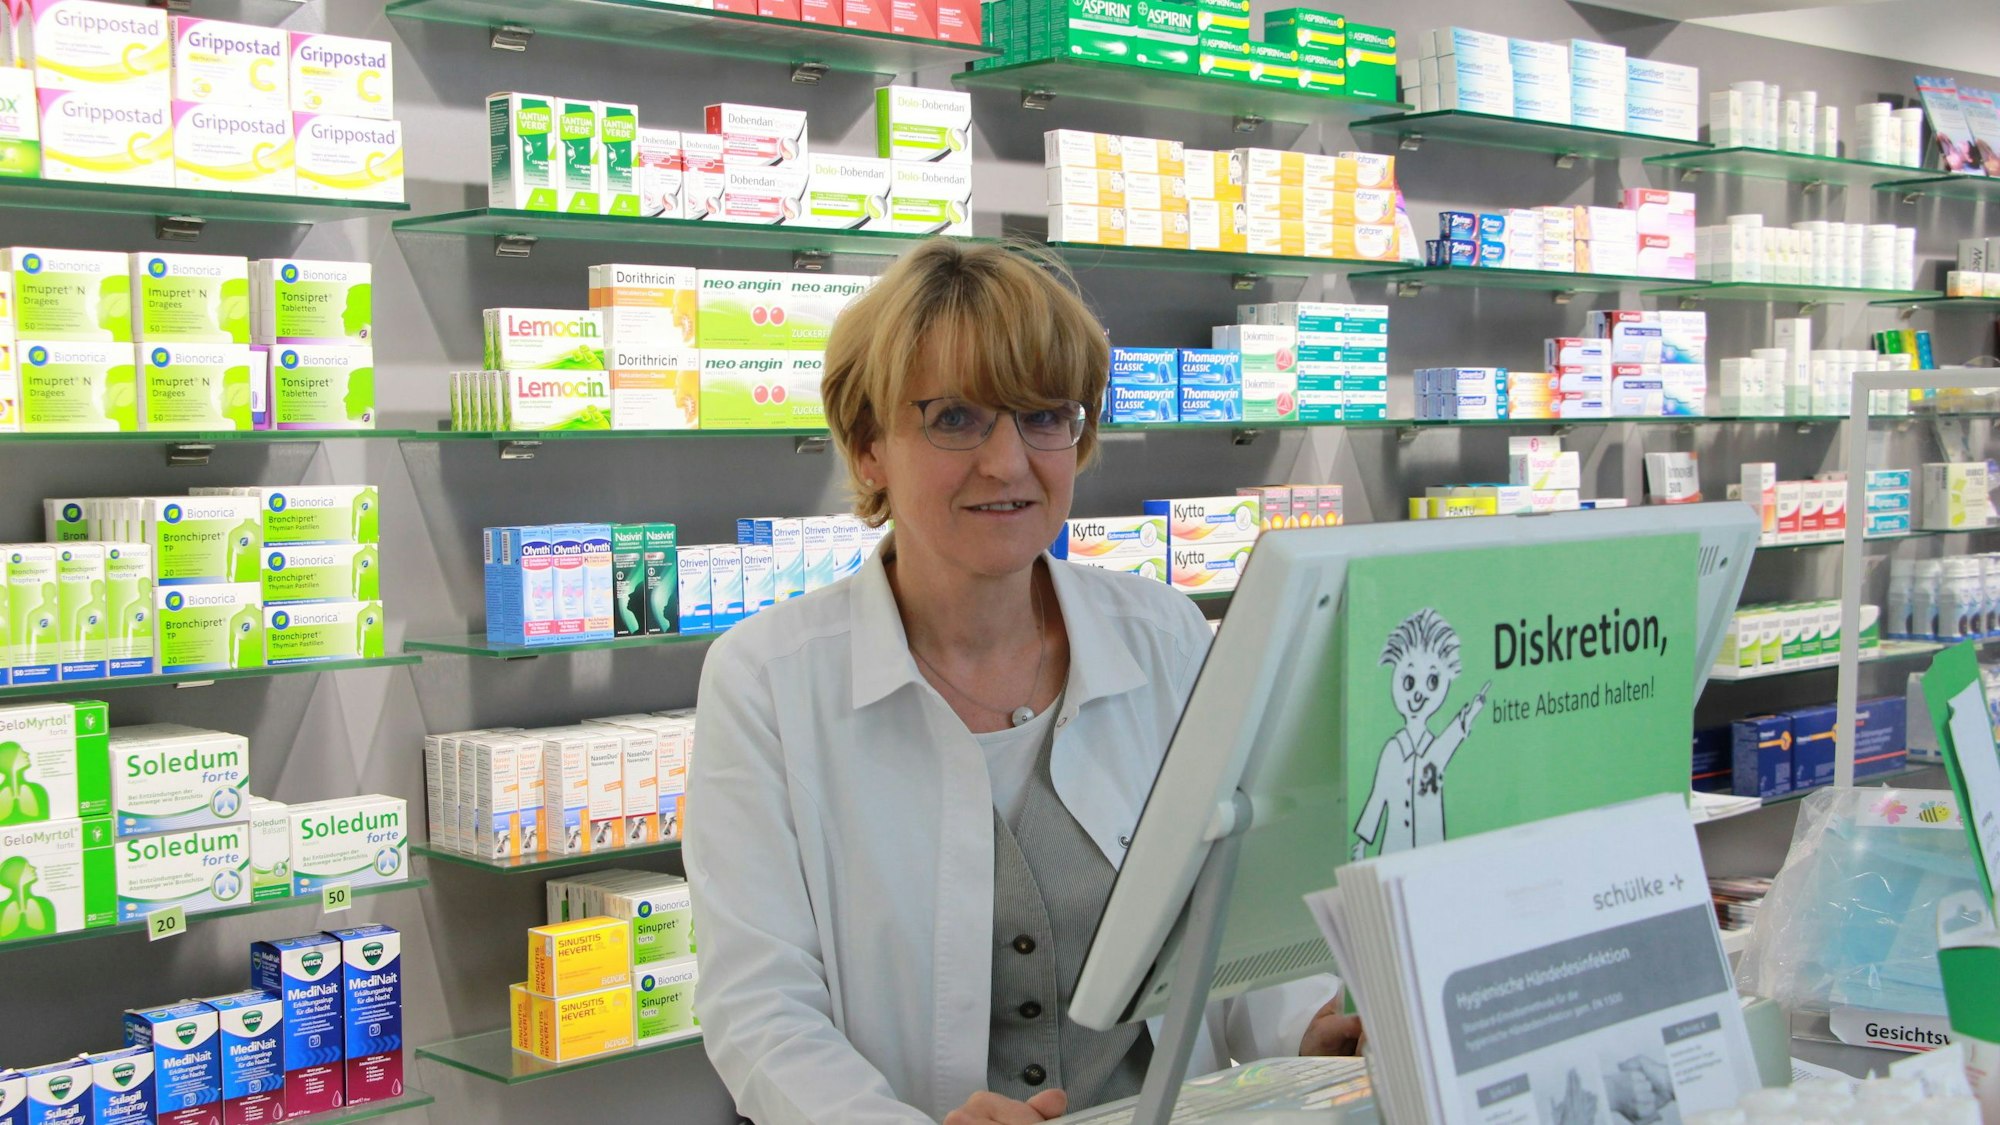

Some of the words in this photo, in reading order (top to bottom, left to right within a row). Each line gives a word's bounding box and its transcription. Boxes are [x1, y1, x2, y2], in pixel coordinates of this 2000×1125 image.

[1082, 0, 1130, 19] ASPIRIN
[1147, 10, 1192, 28] ASPIRIN
[189, 32, 280, 56] Grippostad
[301, 46, 386, 68] Grippostad
[898, 96, 965, 113] Dolo-Dobendan
[518, 111, 549, 122] TANTUM
[561, 116, 592, 127] TANTUM
[728, 113, 773, 127] Dobendan
[521, 121, 547, 131] VERDE
[603, 119, 634, 130] TANTUM
[564, 126, 590, 135] VERDE
[605, 129, 631, 138] VERDE
[642, 137, 677, 146] Dobendan
[686, 140, 719, 150] Dobendan
[816, 164, 884, 179] Dolo-Dobendan
[898, 170, 965, 184] Dolo-Dobendan
[730, 174, 776, 187] Dobendan
[304, 271, 347, 280] Bionorica
[616, 272, 674, 284] Dorithricin
[23, 284, 68, 295] Imupret
[77, 287, 85, 295] N
[703, 280, 734, 288] neo
[738, 279, 781, 293] angin
[149, 288, 190, 299] Imupret
[282, 292, 328, 303] Tonsipret
[24, 297, 58, 306] Dragees
[149, 301, 181, 310] Dragees
[509, 315, 596, 337] Lemocin
[304, 356, 348, 365] Bionorica
[619, 354, 678, 366] Dorithricin
[1114, 350, 1174, 363] Thomapyrin
[1183, 351, 1239, 364] Thomapyrin
[793, 360, 821, 368] neo
[1114, 362, 1143, 372] CLASSIC
[1183, 364, 1210, 372] CLASSIC
[30, 377, 74, 388] Imupret
[282, 378, 329, 388] Tonsipret
[518, 377, 604, 397] Lemocin
[30, 390, 65, 398] Dragees
[153, 390, 185, 398] Dragees
[1115, 387, 1174, 400] Thomapyrin
[1183, 388, 1239, 400] Thomapyrin
[1116, 400, 1144, 409] CLASSIC
[1183, 400, 1210, 408] CLASSIC
[291, 498, 334, 507] Bionorica
[187, 509, 234, 518] Bionorica
[1174, 504, 1204, 522] Kytta
[164, 532, 221, 543] Bronchipret
[616, 532, 642, 541] Nasivin
[646, 531, 674, 540] Nasivin
[1073, 523, 1104, 541] Kytta
[523, 545, 550, 556] Olynth
[554, 544, 580, 555] Olynth
[584, 541, 610, 552] Olynth
[290, 557, 334, 566] Bionorica
[680, 559, 708, 568] Otriven
[712, 557, 740, 567] Otriven
[268, 574, 313, 582] Bronchipret
[188, 596, 235, 605] Bionorica
[166, 619, 222, 630] Bronchipret
[294, 614, 338, 624] Bionorica
[272, 632, 318, 641] Bronchipret
[1494, 608, 1667, 670] Diskretion,
[1493, 695, 1529, 723] bitte
[1536, 686, 1600, 717] Abstand
[1605, 676, 1654, 709] halten!
[0, 716, 67, 732] GeloMyrtol
[128, 750, 238, 777] Soledum
[202, 771, 238, 783] forte
[253, 819, 286, 827] Soledum
[301, 812, 398, 839] Soledum
[263, 826, 286, 835] Balsam
[4, 830, 74, 847] GeloMyrtol
[367, 831, 398, 843] forte
[128, 833, 238, 862] Soledum
[202, 854, 239, 867] forte
[329, 890, 344, 904] 50
[1593, 876, 1664, 911] schülke
[157, 917, 175, 932] 20
[638, 921, 675, 934] Sinupret
[558, 934, 601, 948] SINUSITIS
[363, 949, 382, 957] WICK
[349, 974, 397, 990] MediNait
[288, 984, 337, 1000] MediNait
[354, 986, 393, 997] Erkältungssirup
[375, 993, 390, 1001] Nacht
[1456, 976, 1525, 1010] Hygienische
[293, 997, 333, 1008] Erkältungssirup
[562, 998, 604, 1011] SINUSITIS
[642, 994, 679, 1007] Sinupret
[296, 1007, 305, 1015] für
[315, 1004, 330, 1012] Nacht
[230, 1039, 276, 1056] MediNait
[164, 1052, 211, 1069] MediNait
[50, 1082, 71, 1090] WICK
[109, 1092, 141, 1106] Sulagil
[45, 1106, 79, 1120] Sulagil
[104, 1101, 147, 1116] Halsspray
